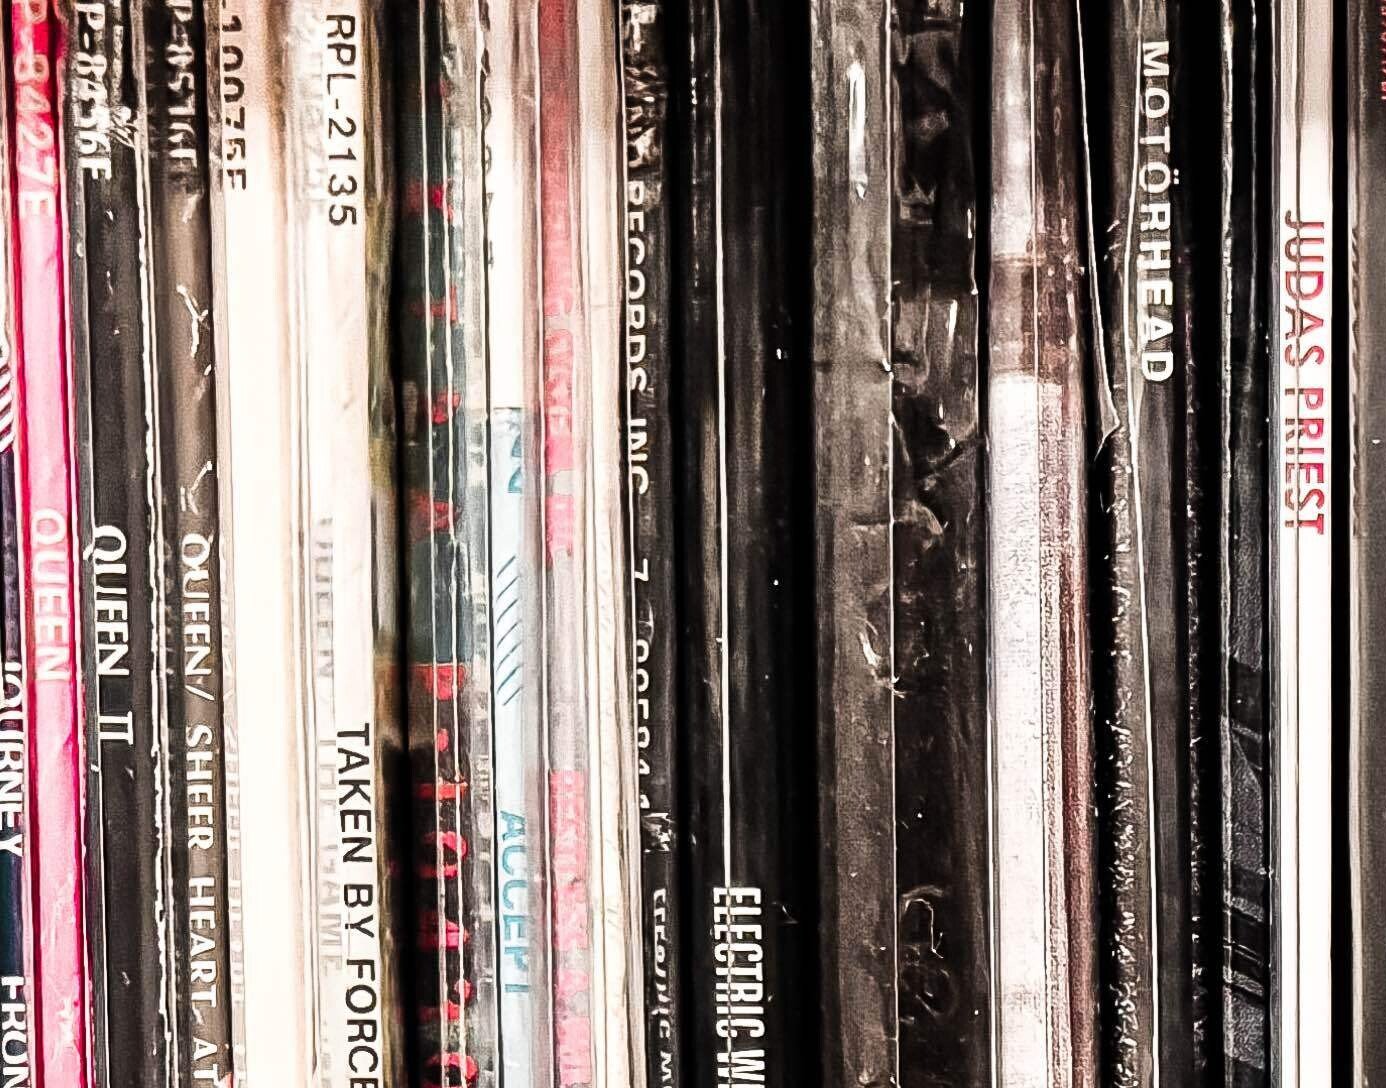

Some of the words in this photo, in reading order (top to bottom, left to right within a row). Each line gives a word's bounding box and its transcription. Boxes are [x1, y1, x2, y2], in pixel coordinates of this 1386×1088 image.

[325, 13, 358, 227] RPL-2135
[1138, 41, 1179, 382] MOTÖRHEAD
[1283, 210, 1326, 366] JUDAS
[1285, 388, 1325, 537] PRIEST
[32, 509, 70, 682] QUEEN
[83, 526, 131, 676] QUEEN
[187, 724, 215, 852] SHEER
[336, 723, 373, 864] TAKEN
[190, 876, 219, 1008] HEART
[344, 884, 377, 939] BY
[500, 811, 535, 995] ACCEPT
[715, 885, 764, 1038] ELECTRIC
